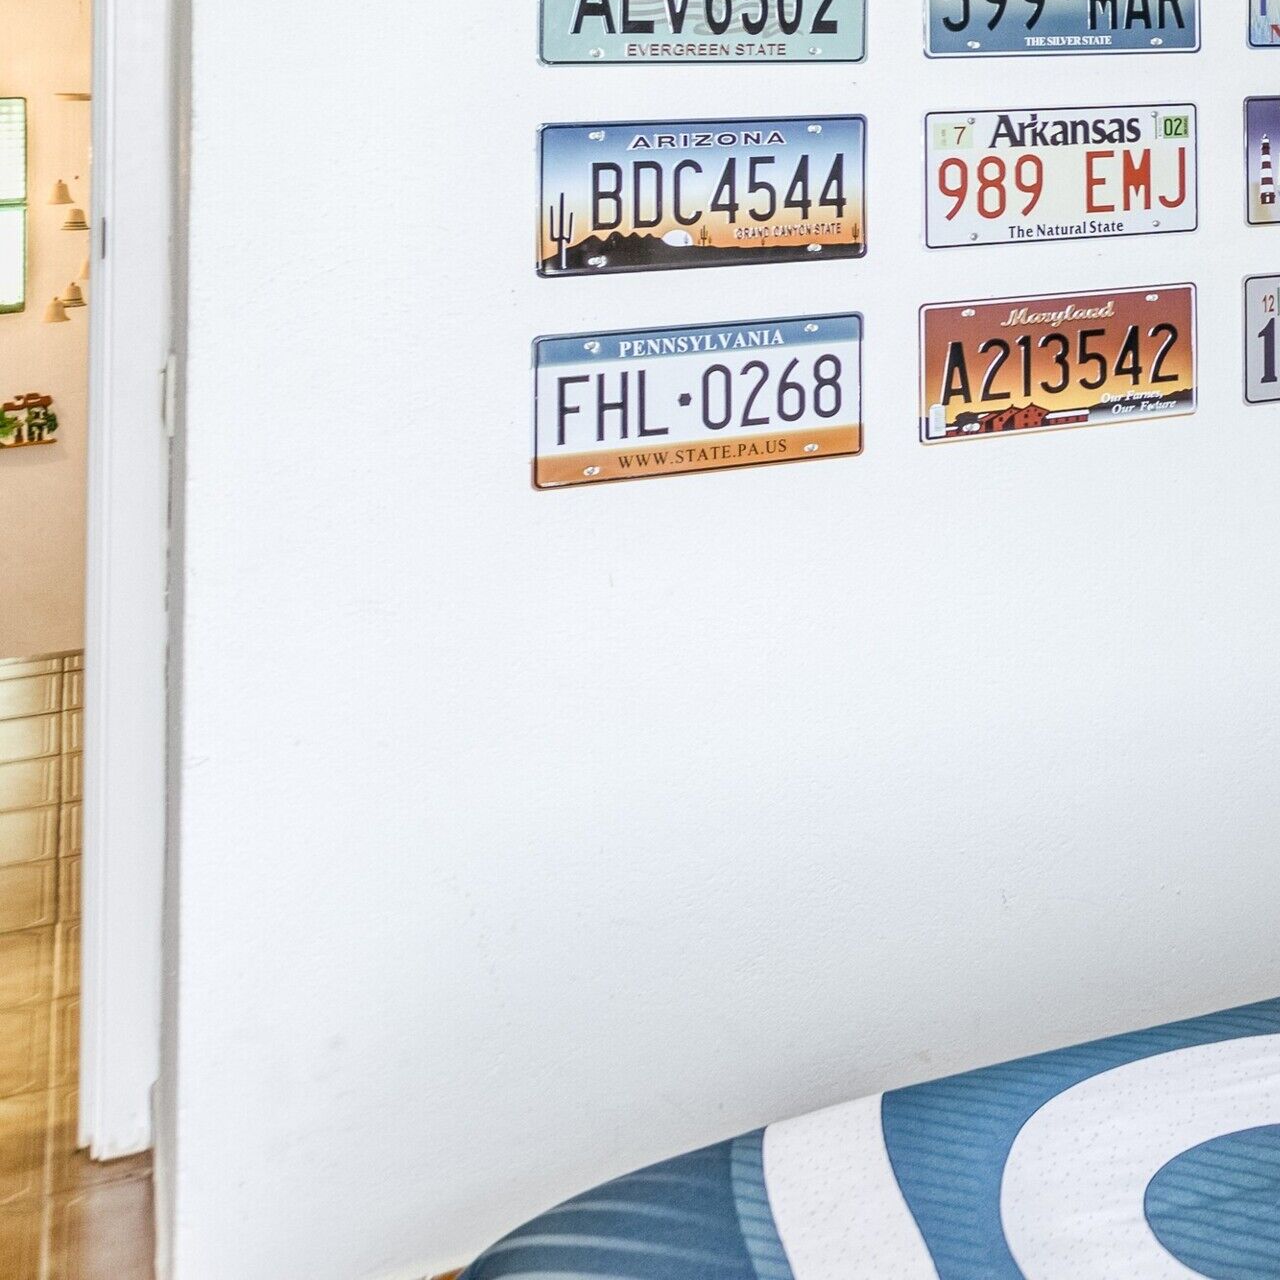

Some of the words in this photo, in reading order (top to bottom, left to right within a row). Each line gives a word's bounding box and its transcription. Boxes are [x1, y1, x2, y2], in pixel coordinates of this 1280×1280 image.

[626, 43, 731, 56] EVERGREEN
[735, 43, 787, 56] STATE
[1024, 37, 1047, 46] THE
[1046, 36, 1082, 46] SILVER
[1082, 35, 1112, 45] STATE
[954, 126, 966, 144] 7
[988, 113, 1142, 149] Arkansas
[1164, 118, 1182, 136] 02
[628, 130, 785, 151] ARIZONA
[591, 152, 847, 232] BDC4544
[938, 154, 1044, 221] 989
[1085, 147, 1186, 213] EMJ
[735, 226, 770, 240] GRAND
[774, 224, 811, 238] CANYON
[814, 223, 842, 235] STATE
[1008, 225, 1033, 238] The
[1037, 221, 1087, 237] Natural
[1090, 221, 1124, 233] State
[1262, 294, 1274, 312] 12
[1000, 301, 1115, 328] Maryland
[618, 329, 785, 358] PENNSYLVANIA
[940, 322, 1179, 406] A213542
[557, 370, 668, 446] FHL
[702, 353, 842, 430] 0268
[1101, 393, 1123, 405] Our
[1124, 390, 1164, 402] Farms,
[1112, 403, 1135, 414] Our
[1140, 400, 1176, 411] Future
[617, 439, 787, 470] WWW.STATE.PA.US
